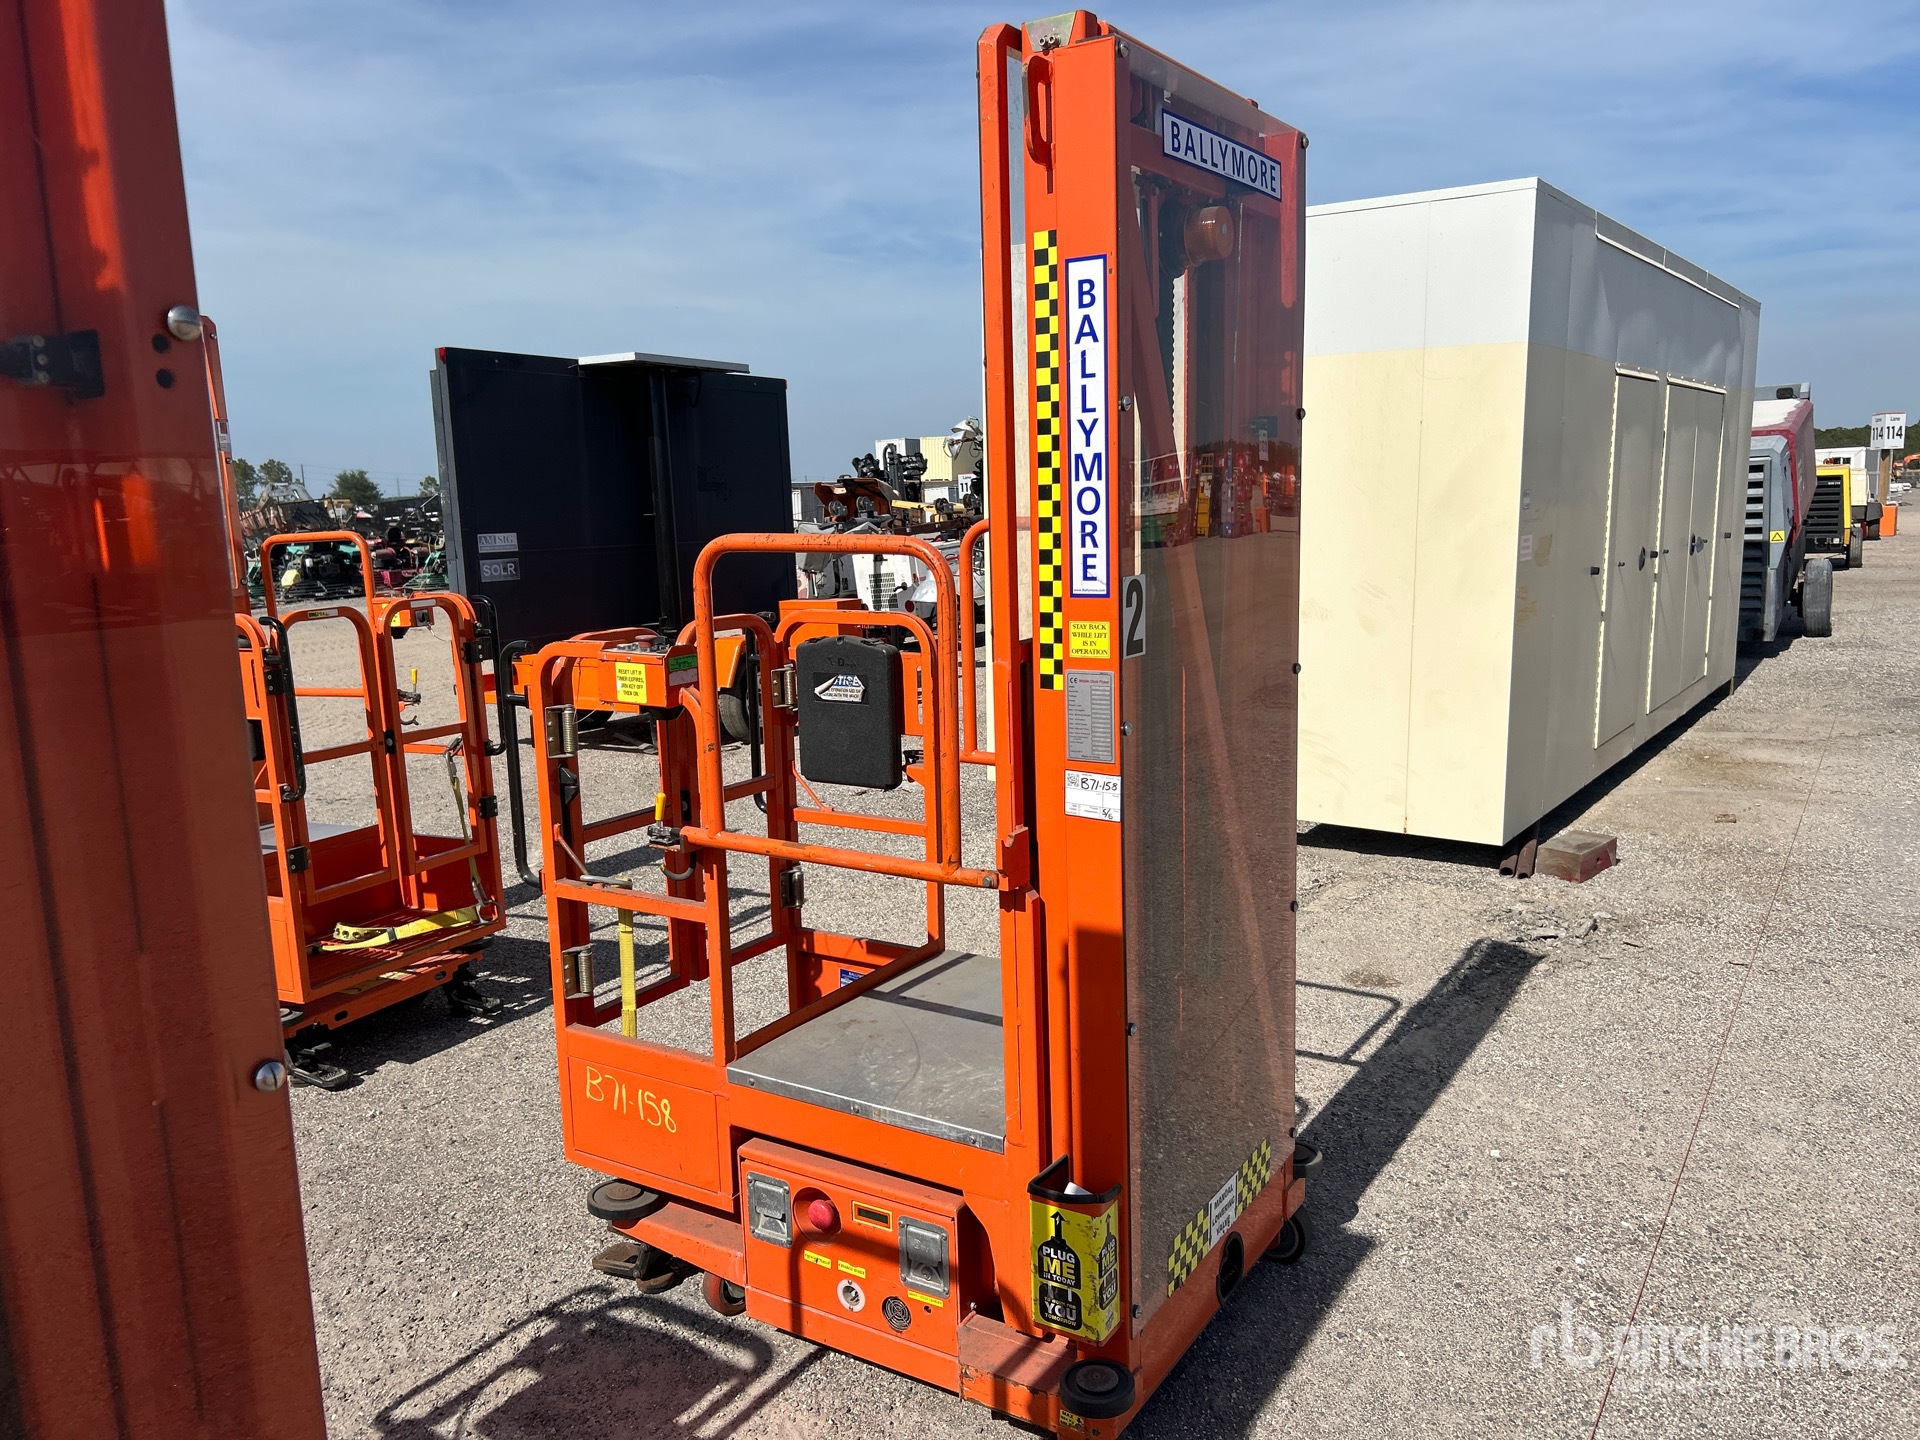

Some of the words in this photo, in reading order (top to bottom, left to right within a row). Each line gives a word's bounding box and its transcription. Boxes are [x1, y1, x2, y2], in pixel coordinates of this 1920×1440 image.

[1170, 120, 1277, 194] BALLYMORE
[1074, 278, 1103, 582] BALLYMORE
[1872, 426, 1884, 441] 114
[1886, 425, 1903, 440] 114
[959, 482, 969, 493] 11
[483, 562, 516, 577] SOLR
[1125, 578, 1144, 657] 2
[1080, 777, 1119, 792] B71-158
[586, 1065, 677, 1134] B71-158
[1042, 1245, 1076, 1264] PLUG
[1101, 1238, 1116, 1258] PLUG
[1042, 1256, 1076, 1280] ME
[1101, 1247, 1116, 1272] ME
[1052, 1274, 1076, 1286] TODAY
[1102, 1282, 1116, 1302] YOU
[1044, 1301, 1077, 1321] YOU
[1044, 1312, 1077, 1327] TOMORROW
